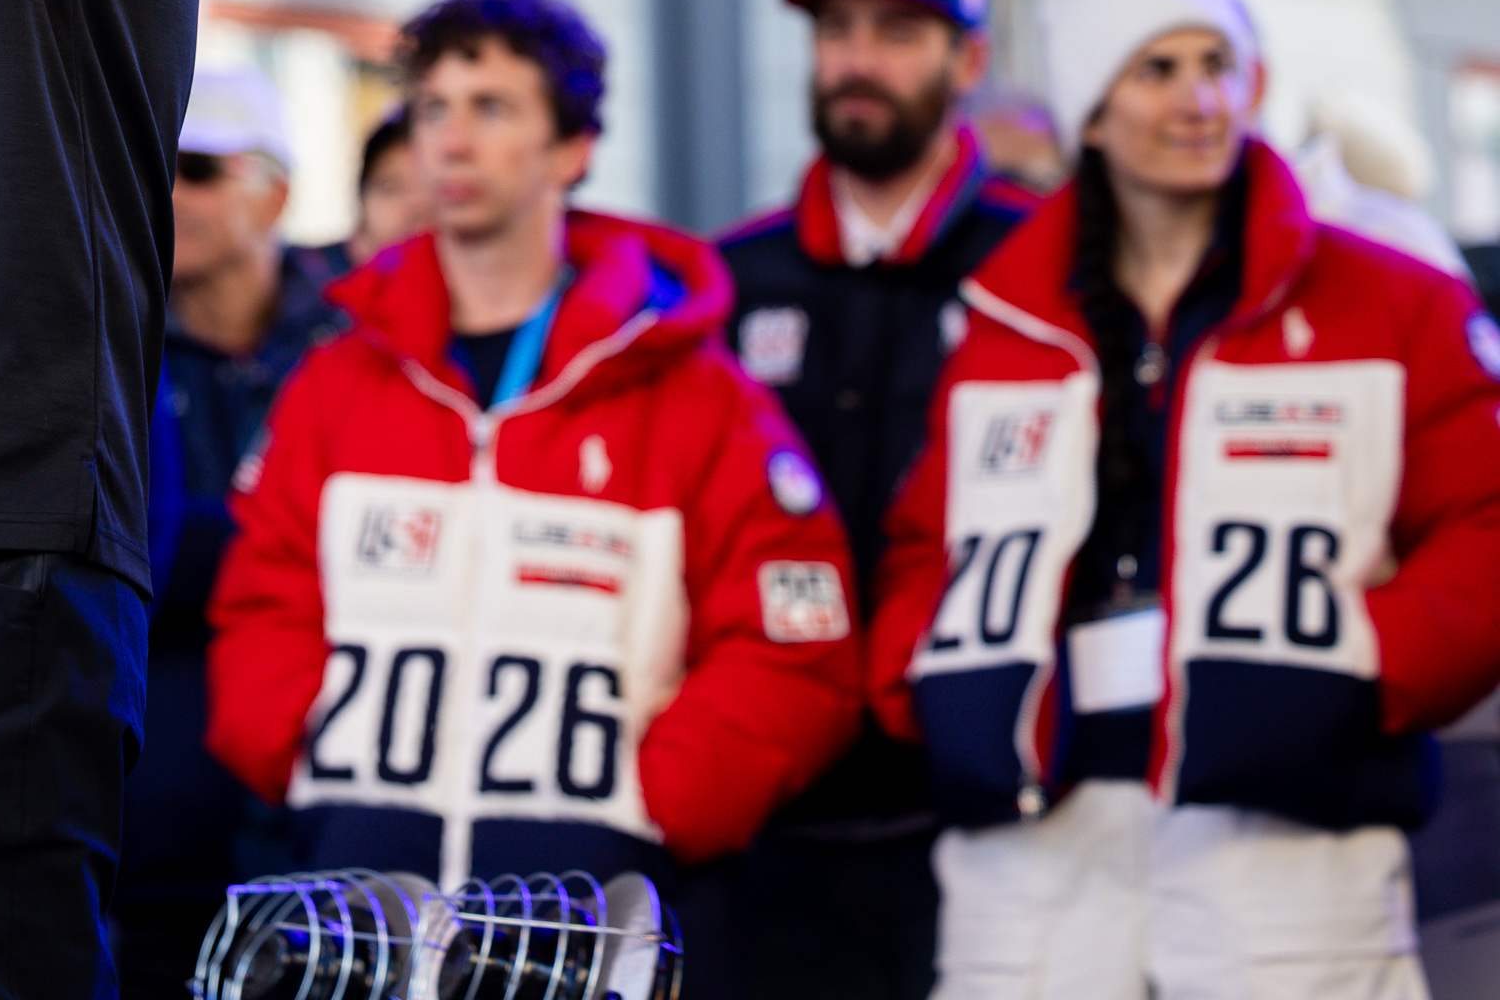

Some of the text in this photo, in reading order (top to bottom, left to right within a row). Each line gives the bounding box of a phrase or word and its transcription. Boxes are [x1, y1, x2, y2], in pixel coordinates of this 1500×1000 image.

[931, 528, 1044, 652] 20
[1204, 521, 1340, 648] 26
[308, 643, 623, 801] 20 26
